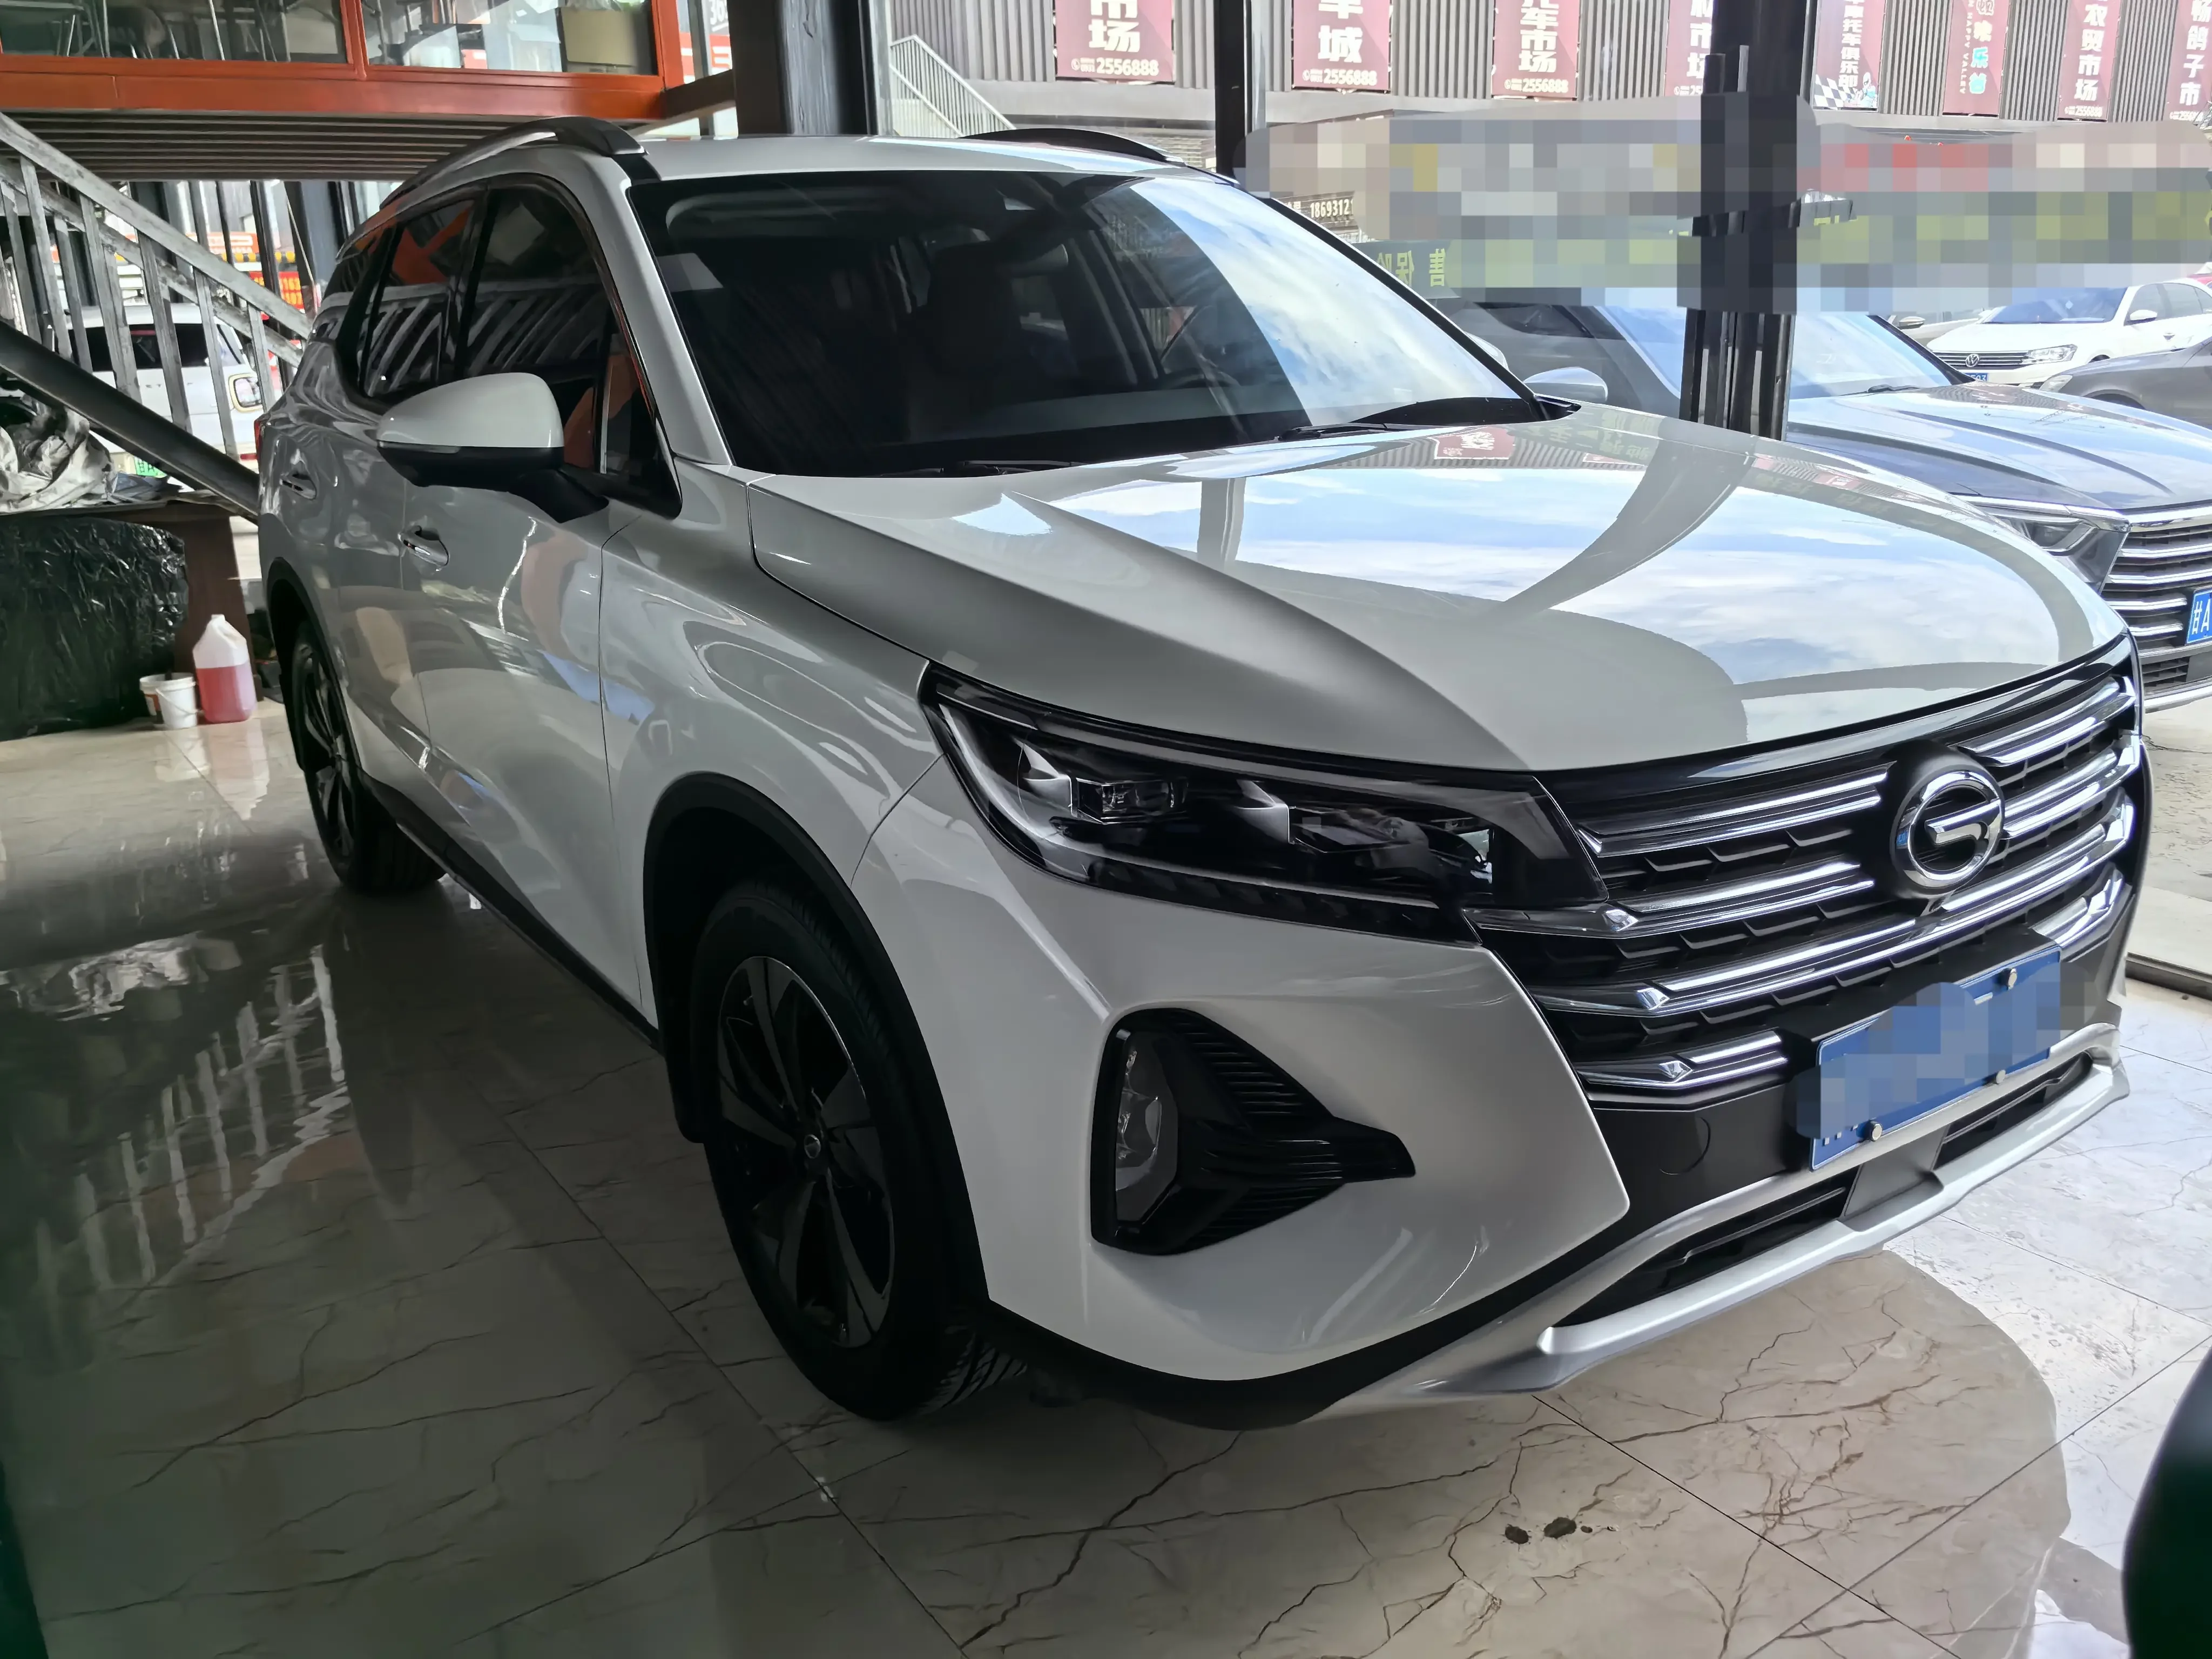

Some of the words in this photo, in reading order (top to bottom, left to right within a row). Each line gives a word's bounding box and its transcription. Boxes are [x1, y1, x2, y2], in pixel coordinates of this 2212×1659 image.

[1096, 57, 1159, 76] 2556888
[1838, 0, 1864, 87] 摩托车俱乐部
[2074, 4, 2108, 101] 农贸市场
[1323, 69, 1378, 86] 2556888
